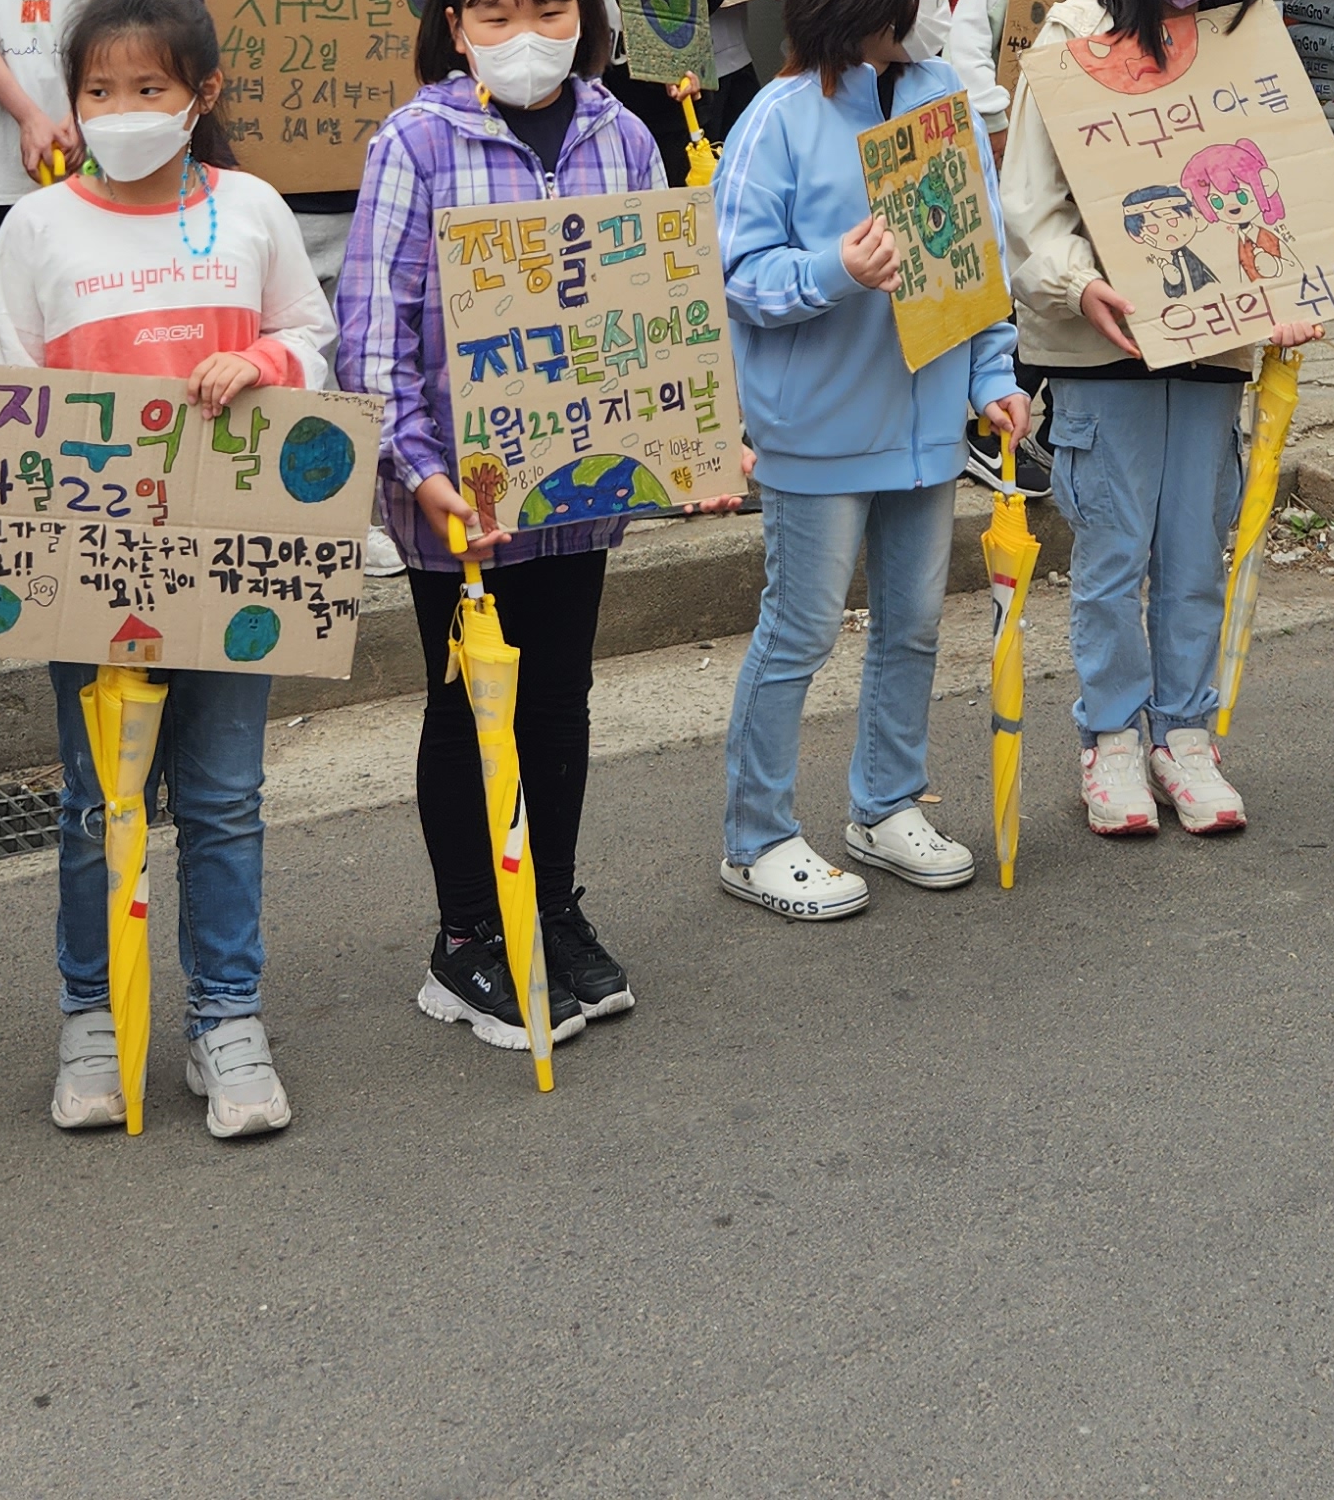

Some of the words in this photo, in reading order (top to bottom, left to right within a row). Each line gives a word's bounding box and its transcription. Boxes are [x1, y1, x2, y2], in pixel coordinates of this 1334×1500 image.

[219, 25, 266, 71] 4월
[1077, 94, 1206, 159] 지구의
[1211, 73, 1290, 117] 아픔
[863, 124, 917, 191] 우리의
[918, 96, 970, 145] 지구는
[74, 271, 124, 298] new
[130, 257, 186, 294] york
[192, 255, 238, 289] city
[447, 212, 593, 310] 전등을
[133, 323, 205, 346] ARCH
[1159, 286, 1276, 355] 우리의
[462, 404, 526, 468] 4월
[528, 396, 593, 454] 22일
[598, 379, 687, 425] 지구의
[686, 370, 722, 435] 날
[211, 404, 271, 492] 날
[643, 437, 665, 467] 딱
[59, 476, 169, 527] 22일
[670, 466, 694, 490] 전등
[761, 891, 820, 915] crocs
[471, 971, 492, 993] FILA
